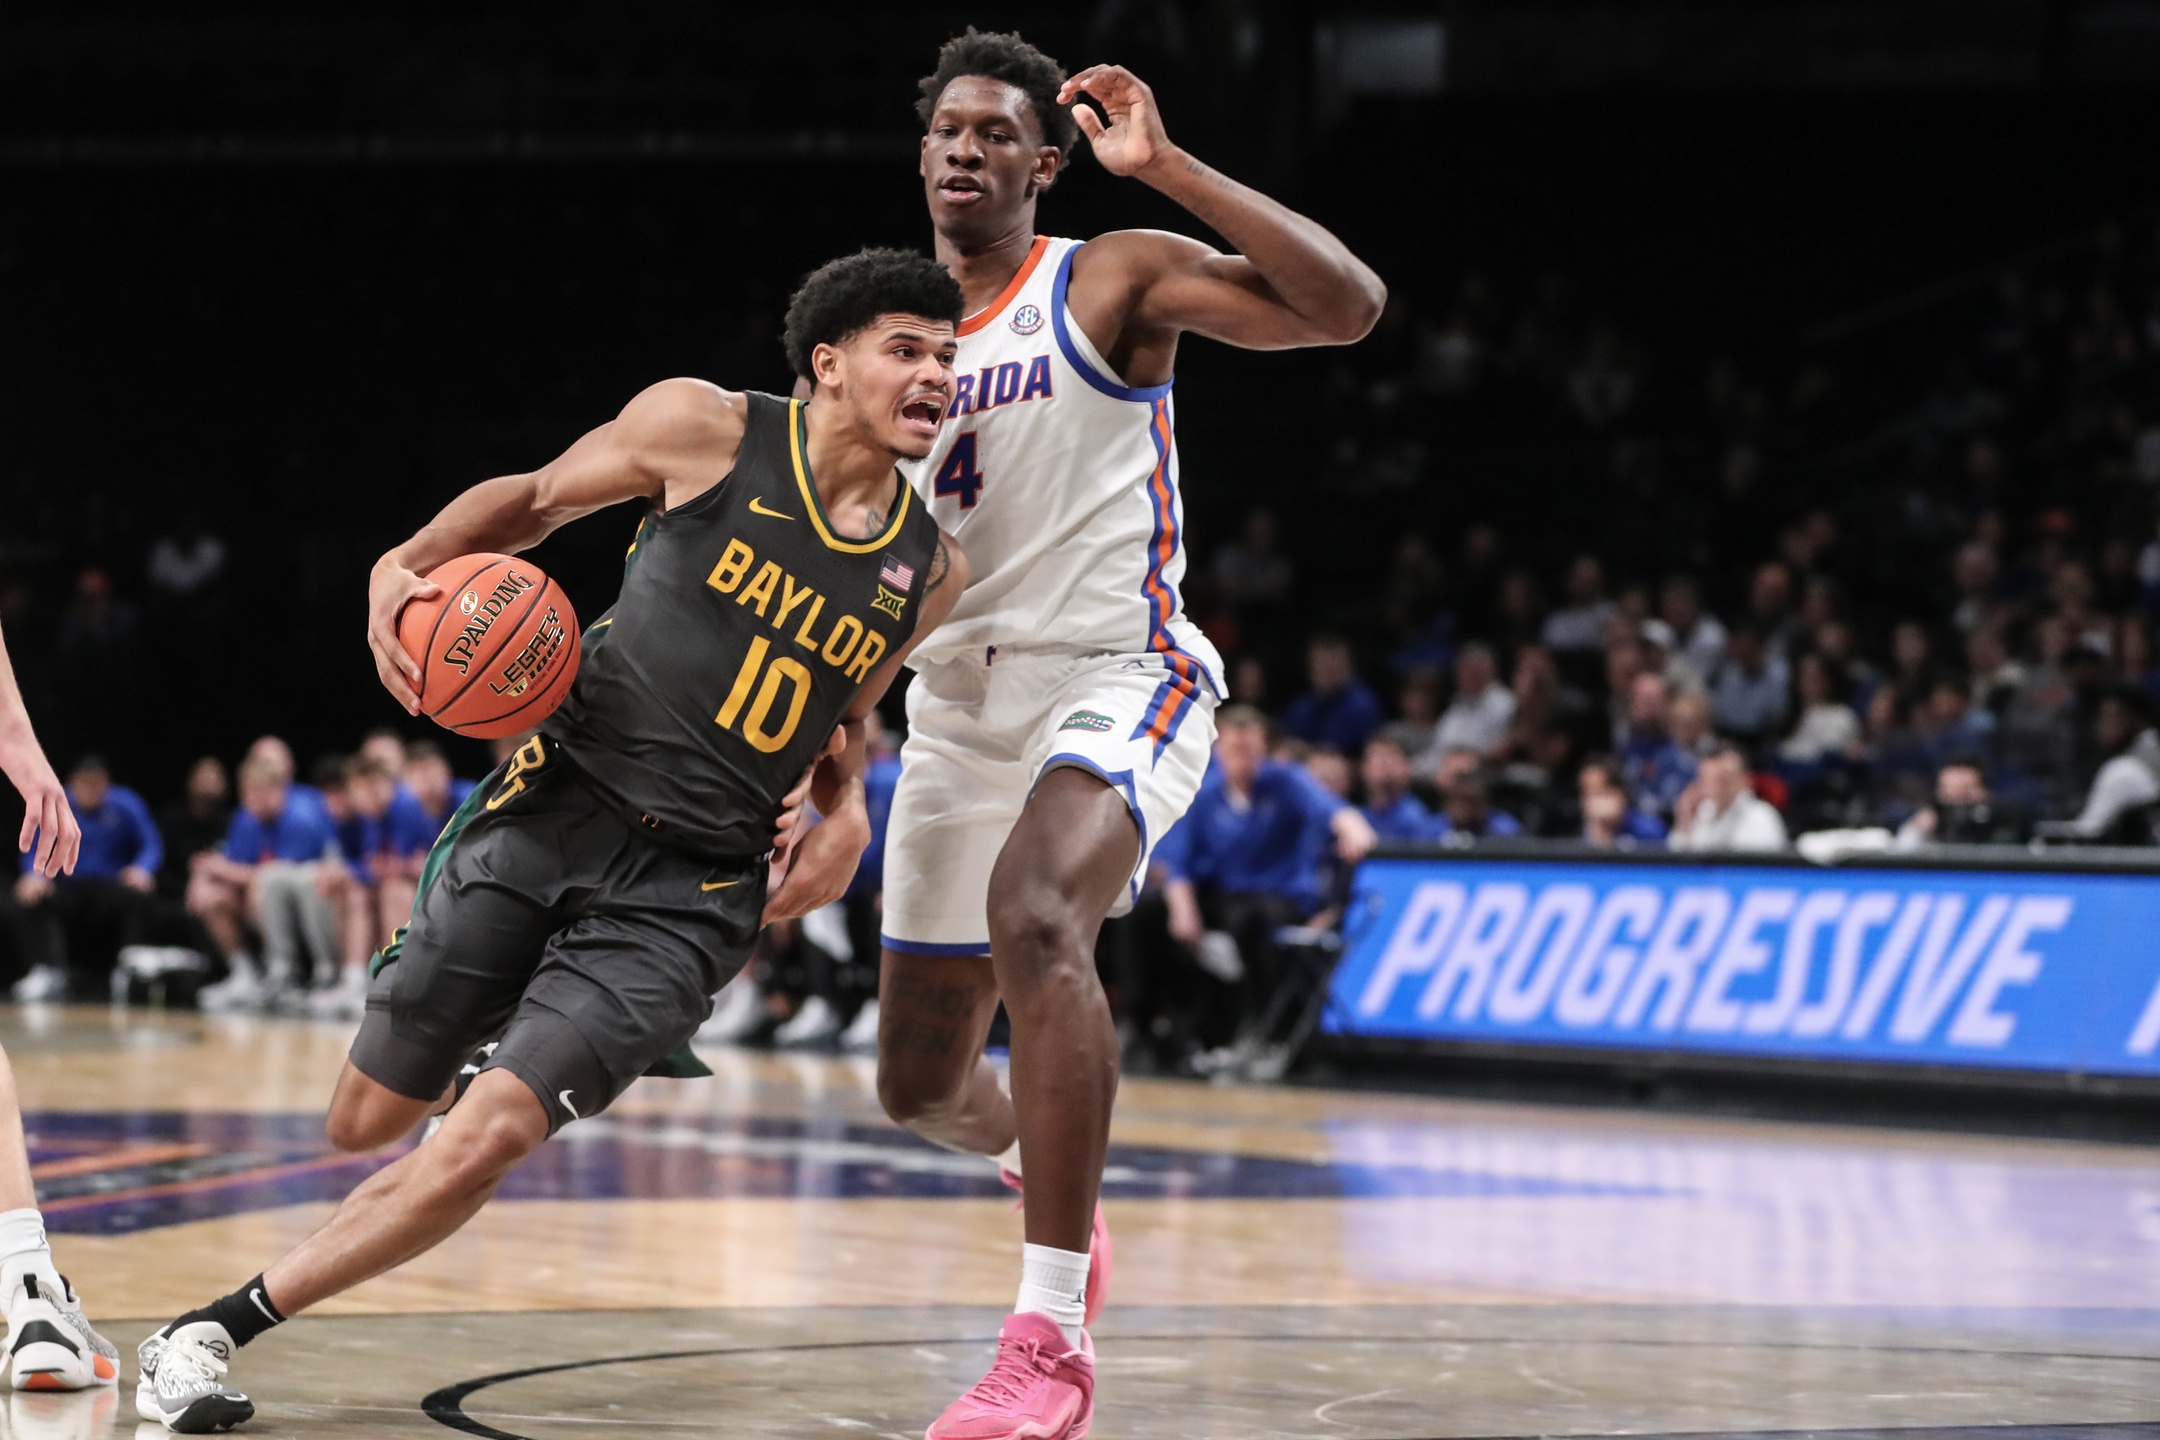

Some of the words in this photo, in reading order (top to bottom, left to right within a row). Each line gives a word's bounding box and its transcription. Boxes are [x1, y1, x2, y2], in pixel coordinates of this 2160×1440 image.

[1016, 306, 1039, 327] SEC
[945, 354, 1053, 420] RIDA
[934, 431, 983, 510] 4
[443, 569, 534, 676] SPALDING
[488, 606, 560, 696] LEGACY
[706, 538, 887, 684] BAYLOR
[714, 635, 812, 753] 10
[1357, 882, 2074, 1049] PROGRESSIVE
